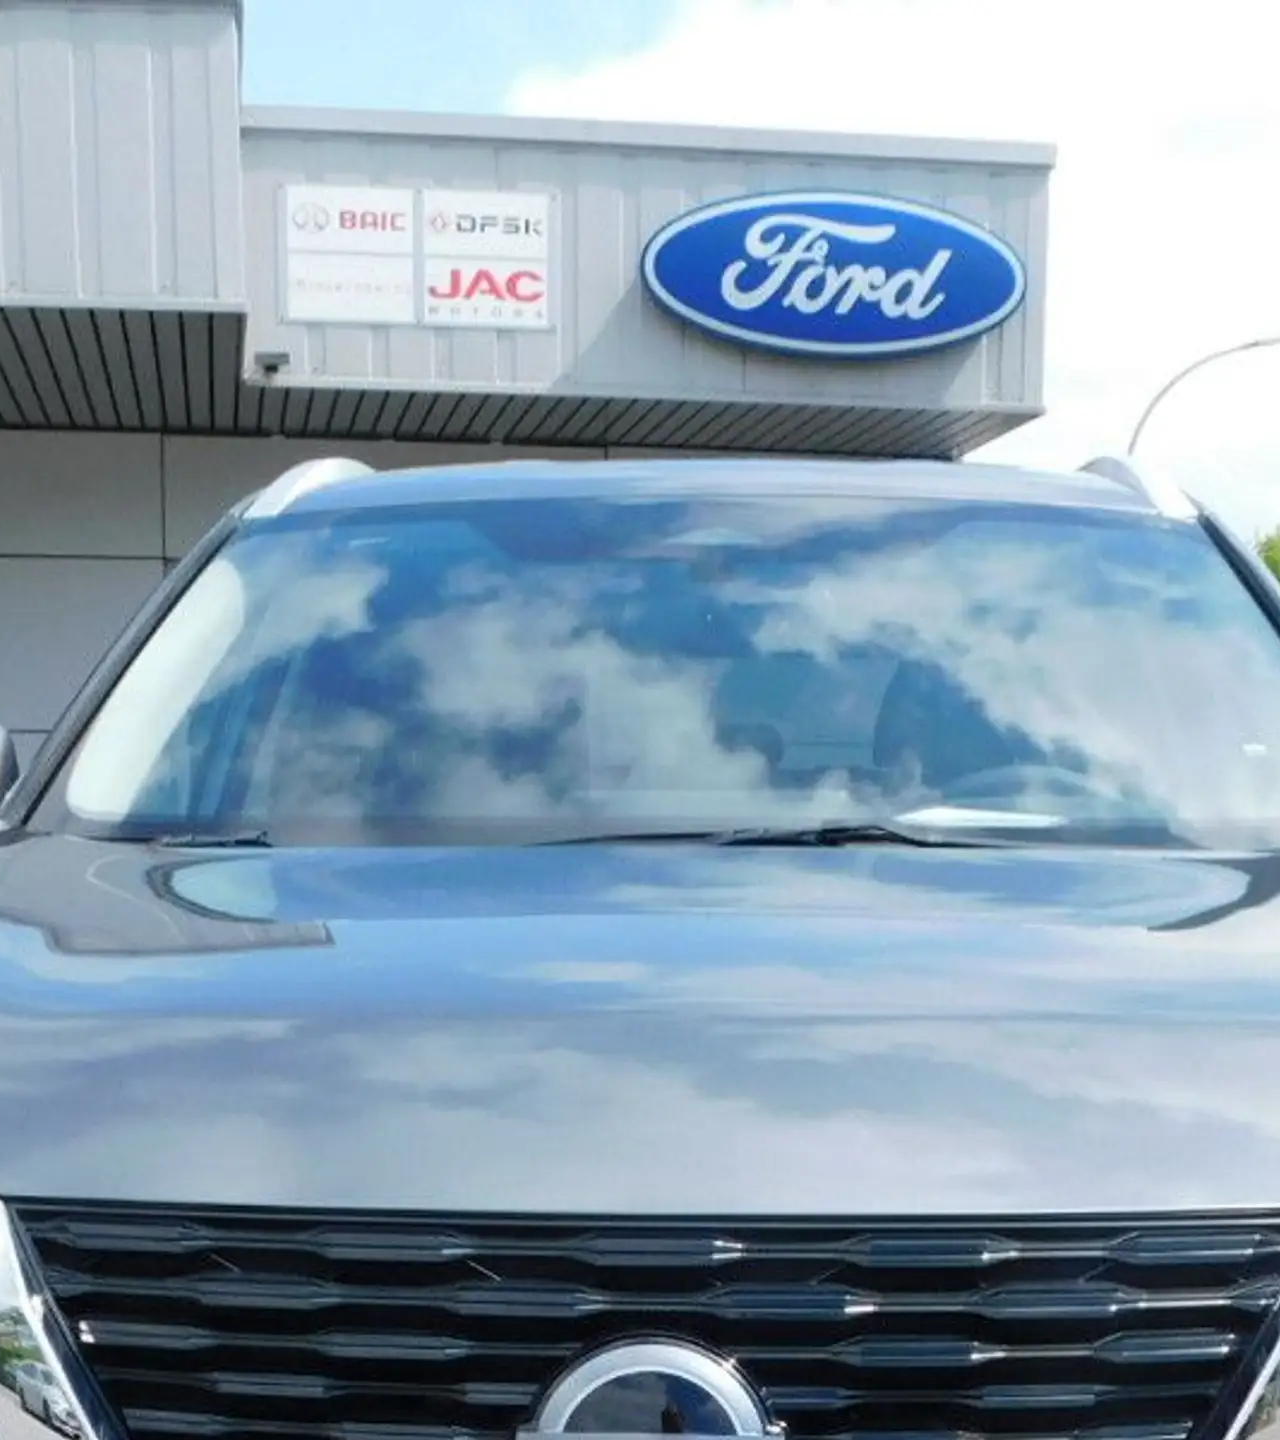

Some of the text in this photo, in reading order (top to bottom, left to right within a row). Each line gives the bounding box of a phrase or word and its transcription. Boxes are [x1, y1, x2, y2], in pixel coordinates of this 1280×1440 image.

[338, 210, 406, 233] BAIC
[455, 213, 543, 236] DFSK
[721, 213, 952, 319] Ford
[428, 268, 544, 303] JAC
